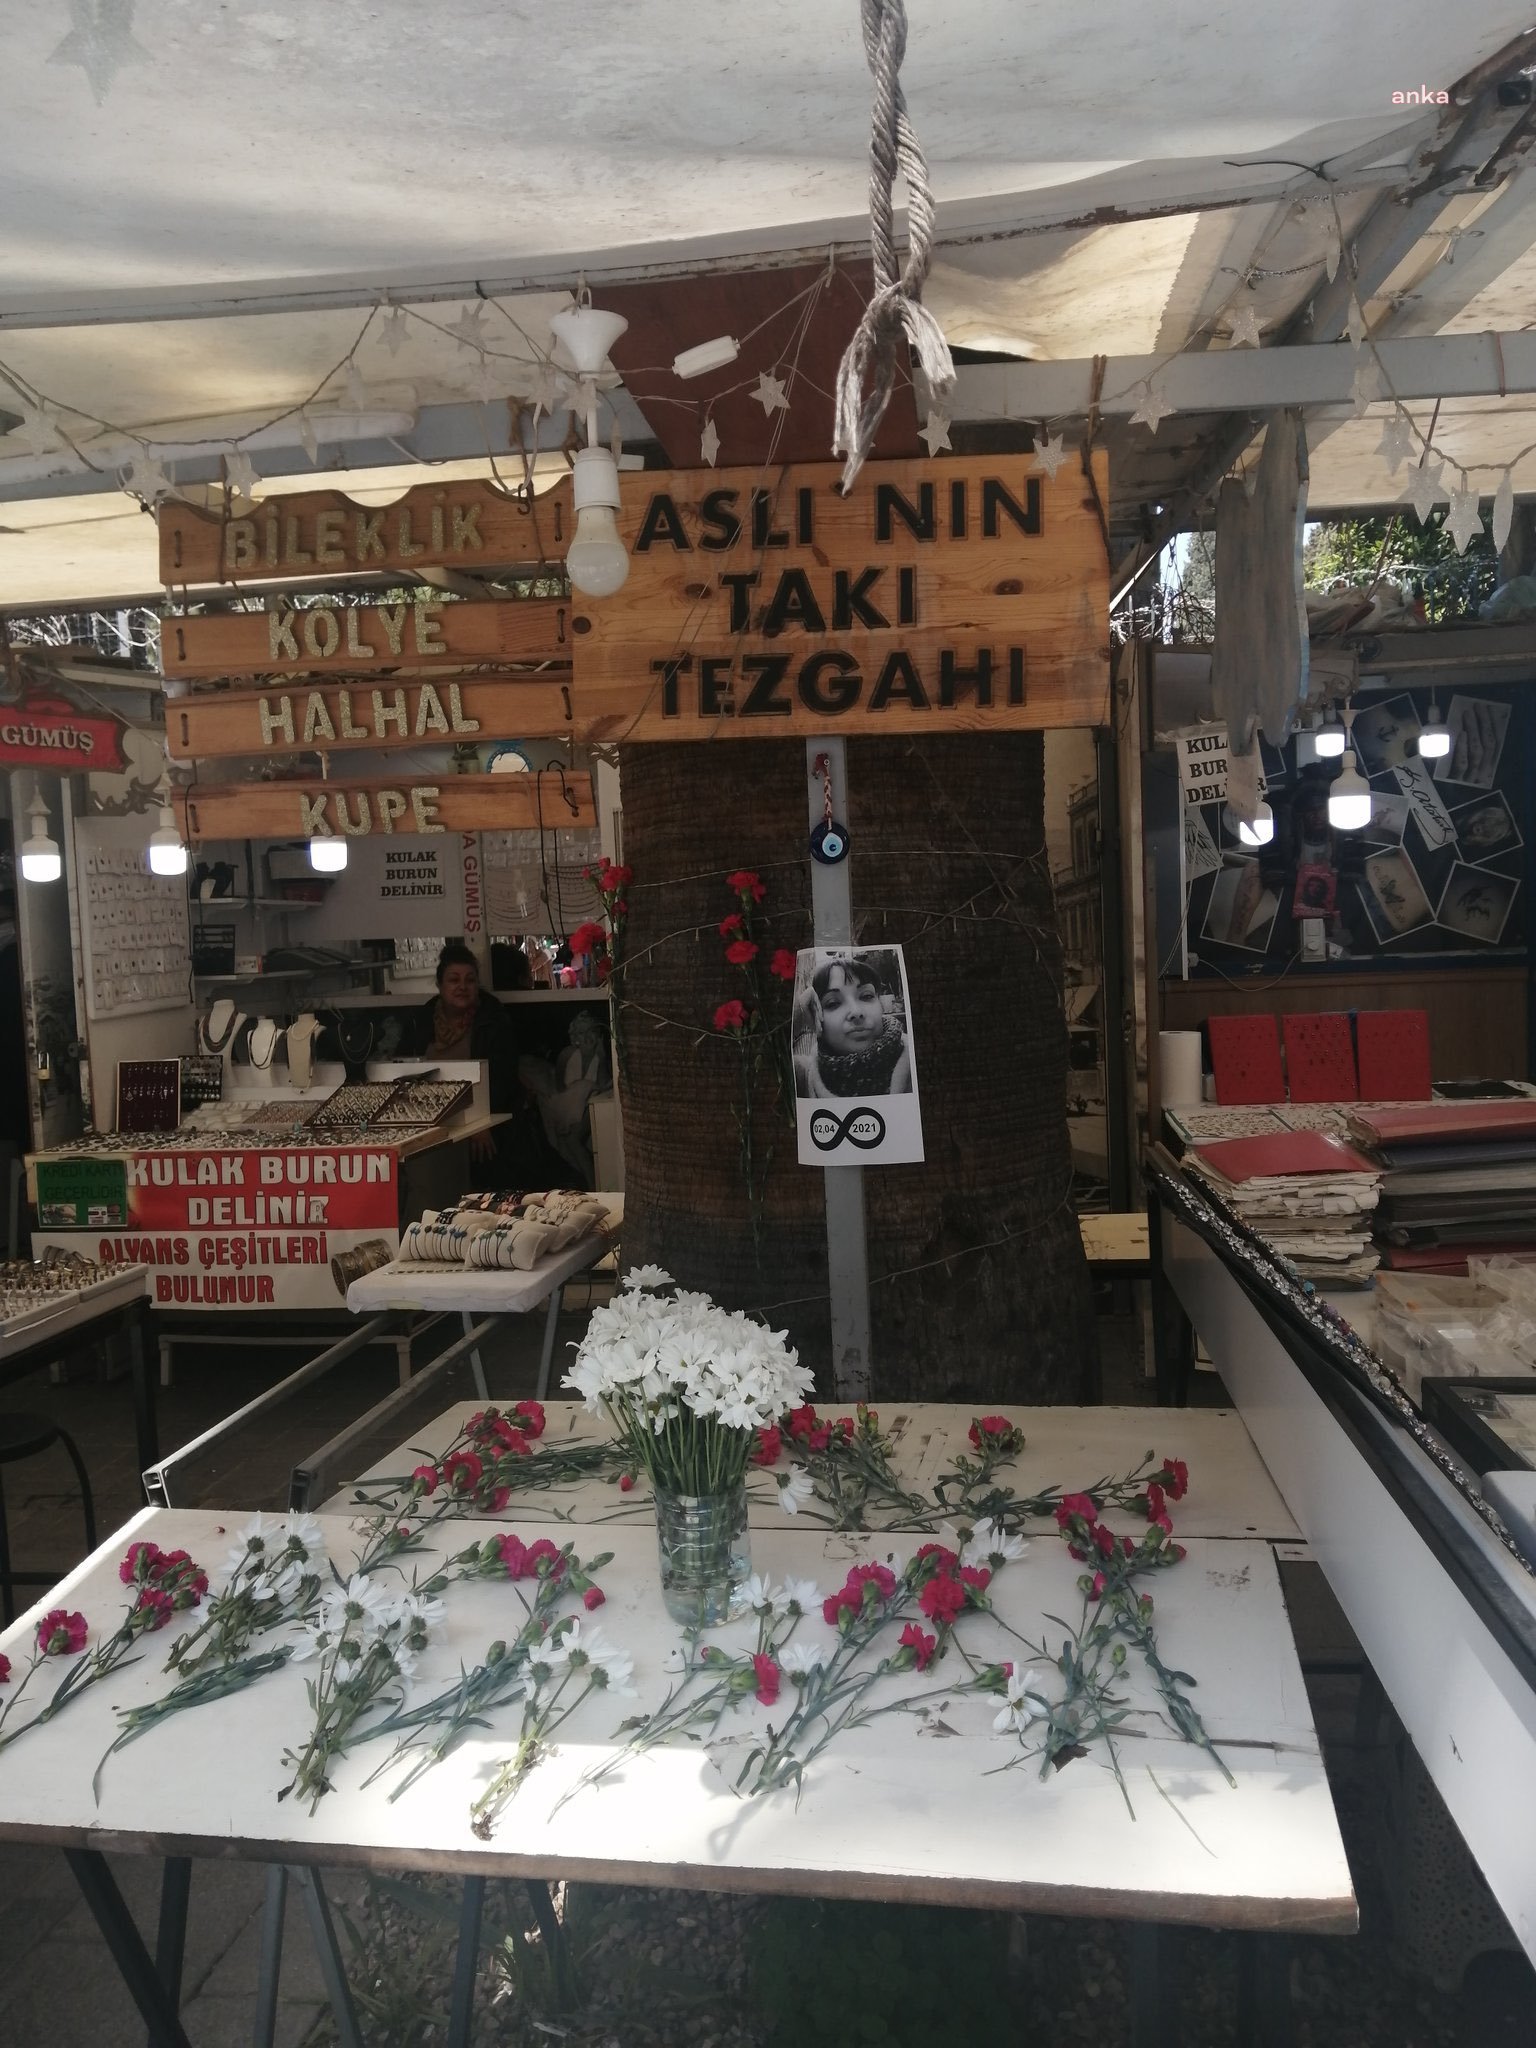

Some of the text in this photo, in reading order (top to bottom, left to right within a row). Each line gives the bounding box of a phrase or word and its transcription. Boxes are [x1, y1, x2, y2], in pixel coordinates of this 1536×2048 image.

[226, 491, 483, 568] BİLEKLİK
[719, 565, 917, 634] TAKI
[269, 601, 447, 661] KOLYE
[650, 646, 1028, 720] TEZGAHI
[259, 683, 480, 745] HALHAL
[1186, 735, 1228, 754] KUL
[1189, 759, 1228, 778] BUR
[300, 787, 446, 837] KUPE
[386, 851, 437, 863] KULAK
[386, 867, 438, 881] BURUN
[381, 882, 443, 897] DELİNİR
[463, 855, 483, 933] GÜMÜŞ
[852, 1123, 876, 1133] 2021
[127, 1153, 391, 1187] KULAK BURUN
[99, 1231, 328, 1270] ALYANS ÇEŞİTLERİ
[156, 1275, 275, 1304] BULUNUR
